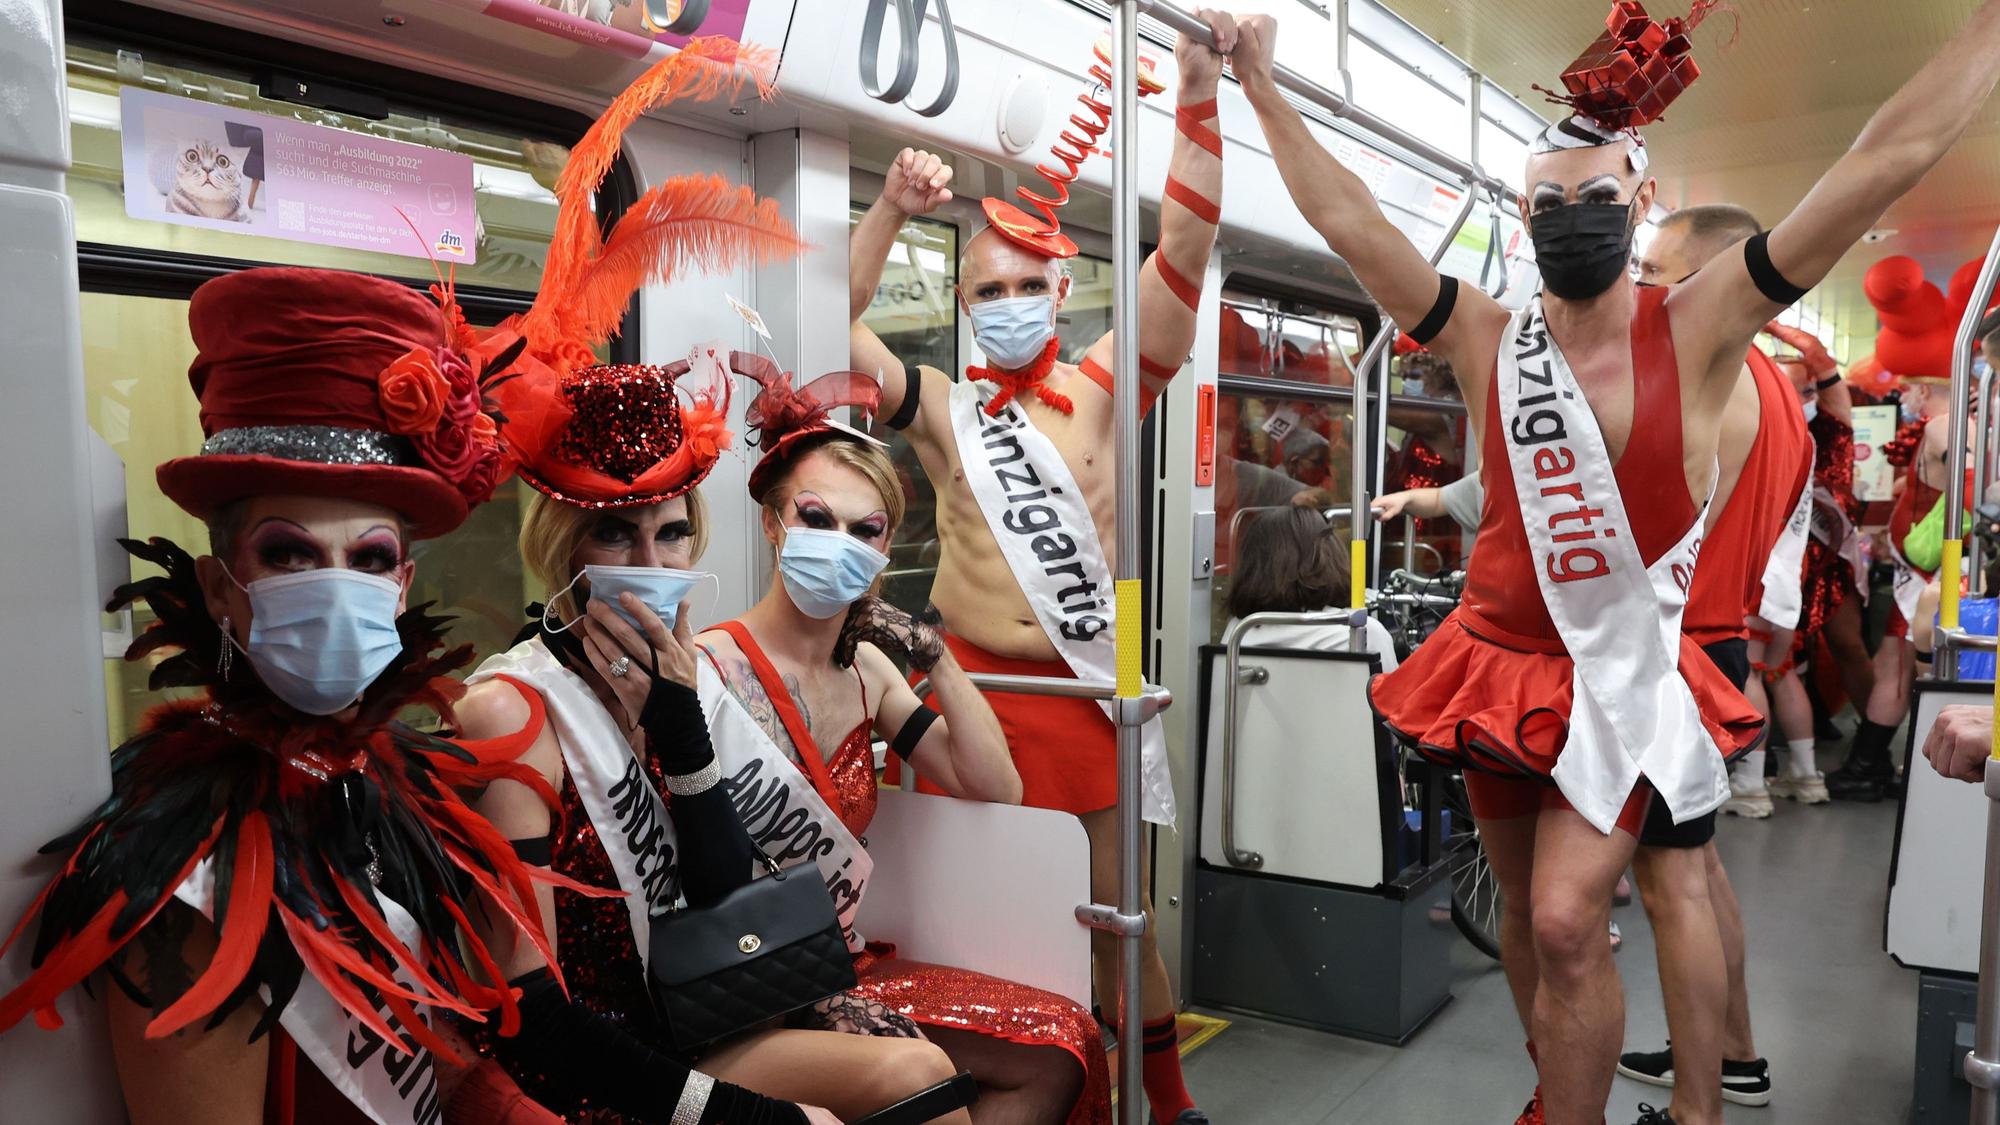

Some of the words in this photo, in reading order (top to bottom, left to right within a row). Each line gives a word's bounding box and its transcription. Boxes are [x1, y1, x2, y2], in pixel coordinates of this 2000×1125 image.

[275, 132, 305, 148] Wenn
[307, 140, 331, 152] man
[276, 149, 305, 163] sucht
[308, 154, 329, 168] und
[332, 157, 348, 171] die
[351, 162, 422, 184] Suchmaschine
[276, 162, 295, 177] 563
[321, 171, 354, 187] Treffer
[357, 178, 396, 195] anzeigt.
[440, 230, 461, 246] dm
